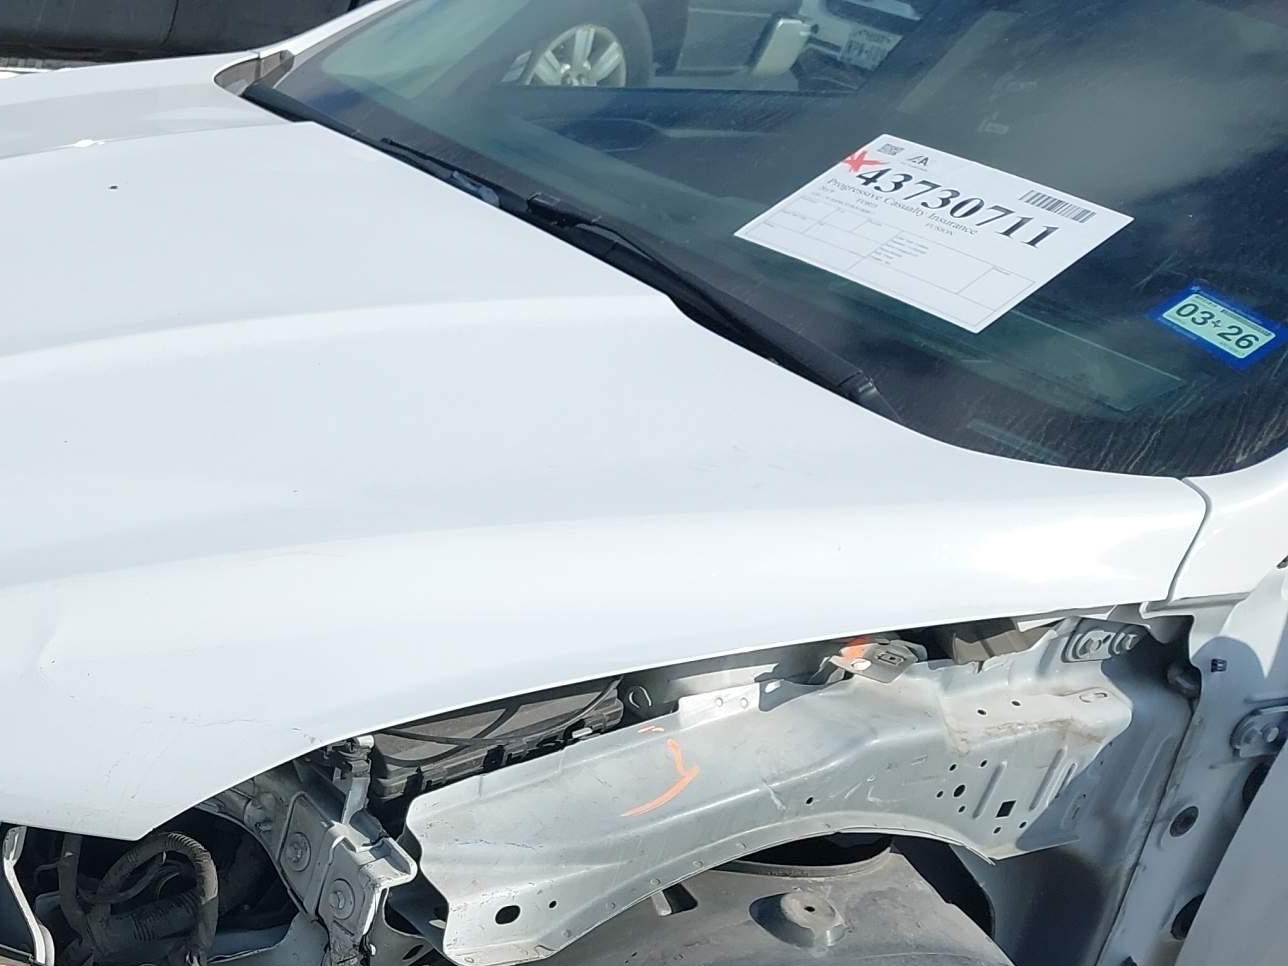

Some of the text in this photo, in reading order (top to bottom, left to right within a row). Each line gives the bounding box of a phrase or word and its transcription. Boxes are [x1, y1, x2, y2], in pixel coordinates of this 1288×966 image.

[826, 177, 884, 201] Progressive
[884, 196, 926, 217] Casualty
[928, 212, 979, 236] Insurance
[856, 168, 1059, 248] 43730711
[1175, 303, 1215, 326] 03
[1216, 325, 1260, 349] 26
